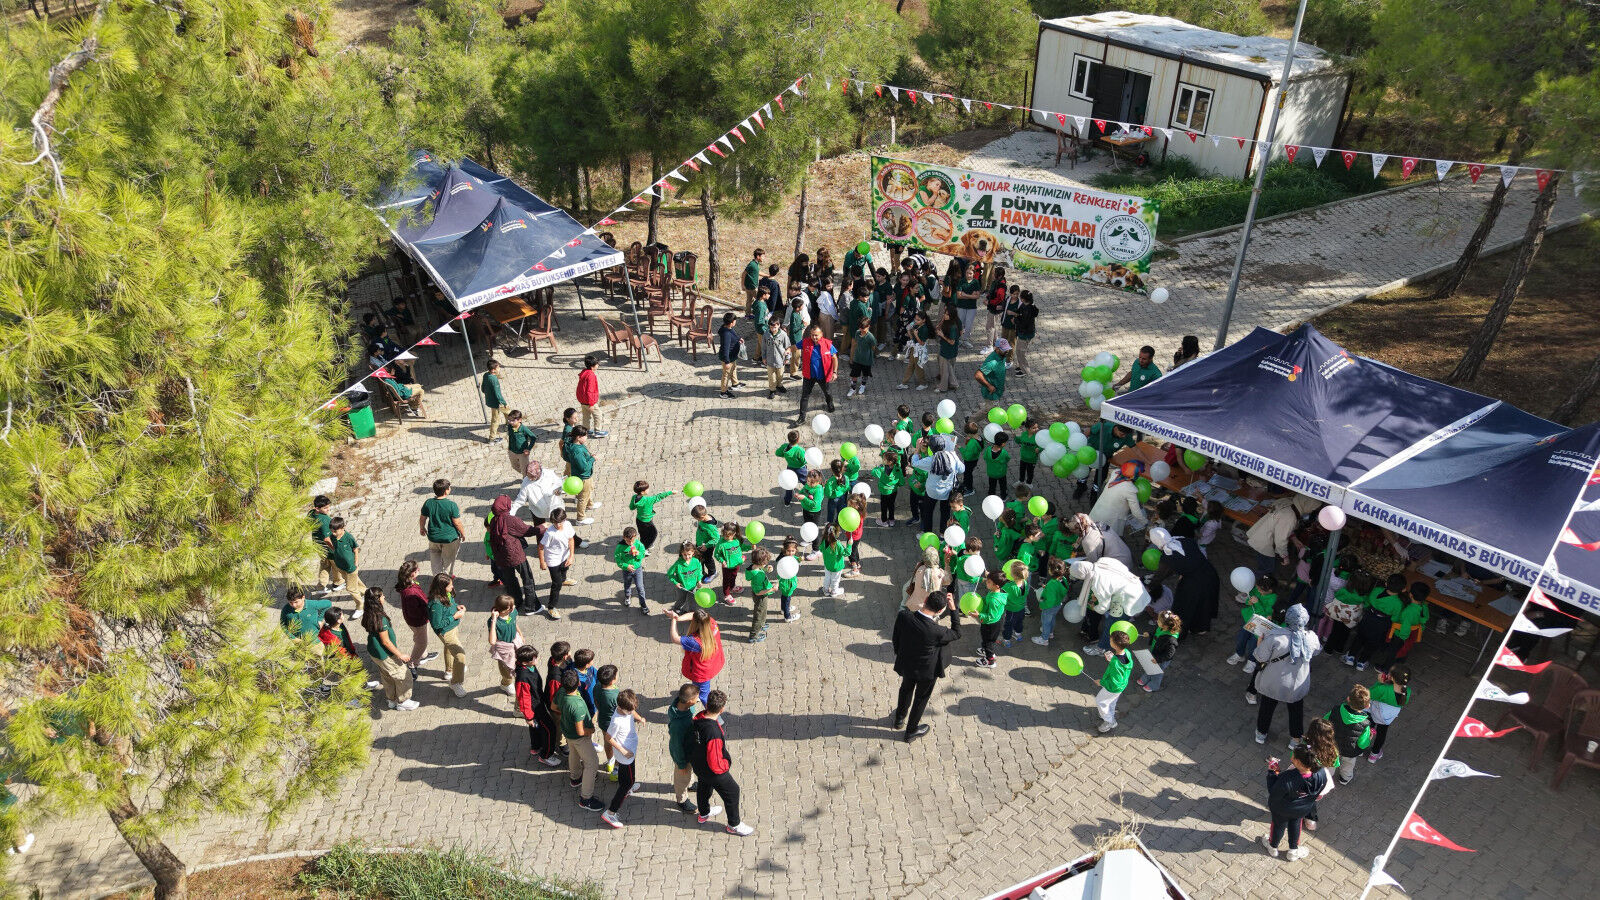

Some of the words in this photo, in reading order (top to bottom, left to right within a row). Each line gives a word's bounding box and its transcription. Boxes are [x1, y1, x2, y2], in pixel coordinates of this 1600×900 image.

[971, 194, 994, 220] 4
[977, 180, 1010, 193] ONLAR
[1013, 183, 1072, 200] HAYATIMIZIN
[1073, 192, 1123, 211] RENKLERİ
[1001, 196, 1063, 217] DÜNYA
[971, 219, 993, 228] EKİM
[1000, 209, 1097, 239] HAYVANLARI
[1000, 224, 1054, 243] KORUMA
[1058, 234, 1094, 250] GÜNÜ
[1012, 237, 1044, 255] Kutlu
[1045, 244, 1085, 260] Olsun
[1114, 411, 1199, 448] KAHRAMANMARAŞ
[1200, 439, 1265, 474] BÜYÜKŞEHİR
[1266, 464, 1332, 499] BELEDİYESİ
[1353, 499, 1478, 558] KAHRAMANMARAŞ
[1478, 549, 1577, 600] BÜYÜKŞEHİR
[1578, 591, 1600, 611] BE
